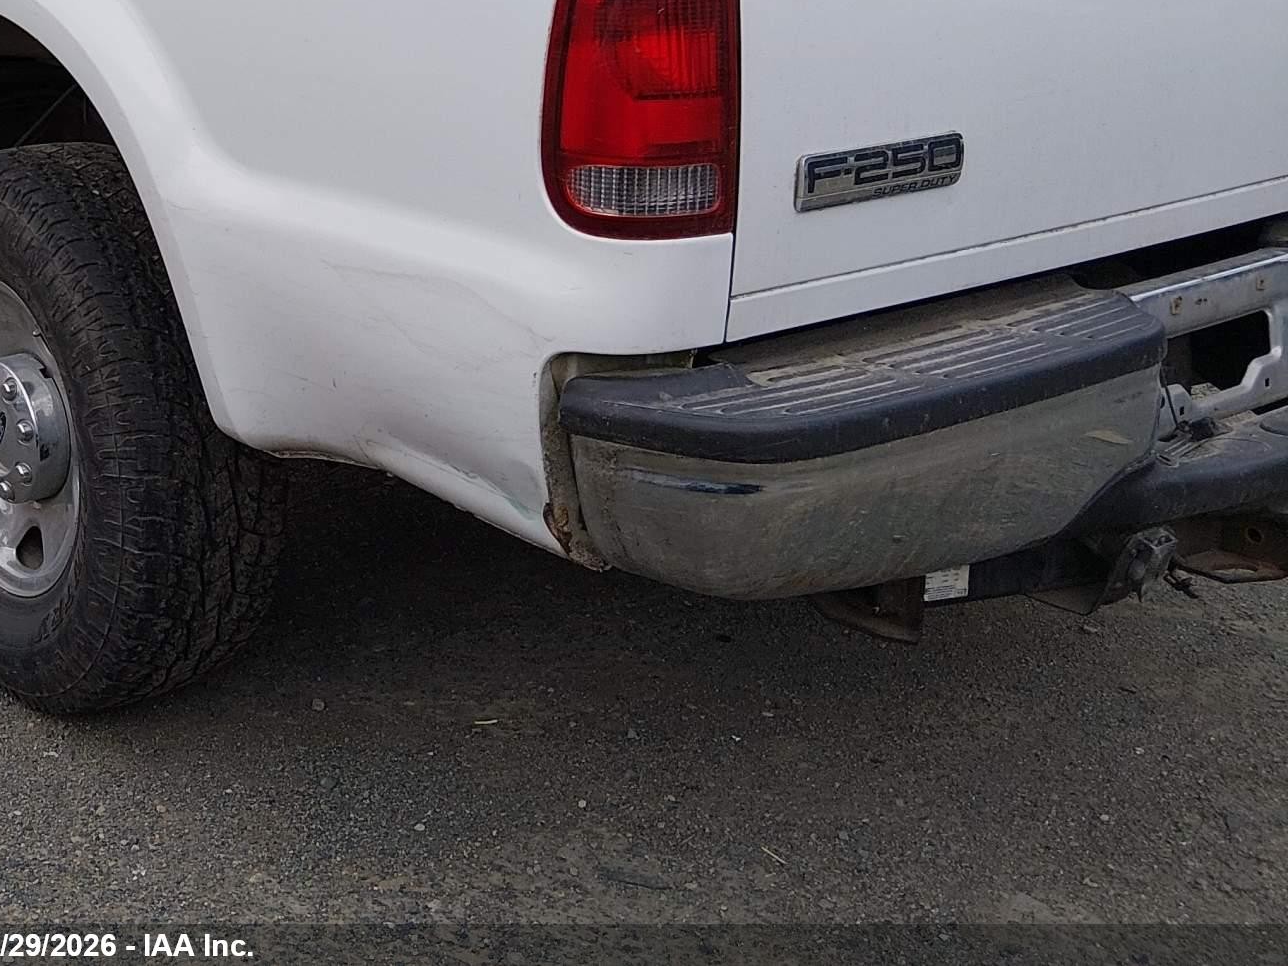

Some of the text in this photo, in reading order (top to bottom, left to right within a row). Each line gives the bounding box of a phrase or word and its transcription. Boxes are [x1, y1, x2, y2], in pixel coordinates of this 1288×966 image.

[807, 136, 964, 194] F-250
[872, 175, 956, 197] SUPER DUTY
